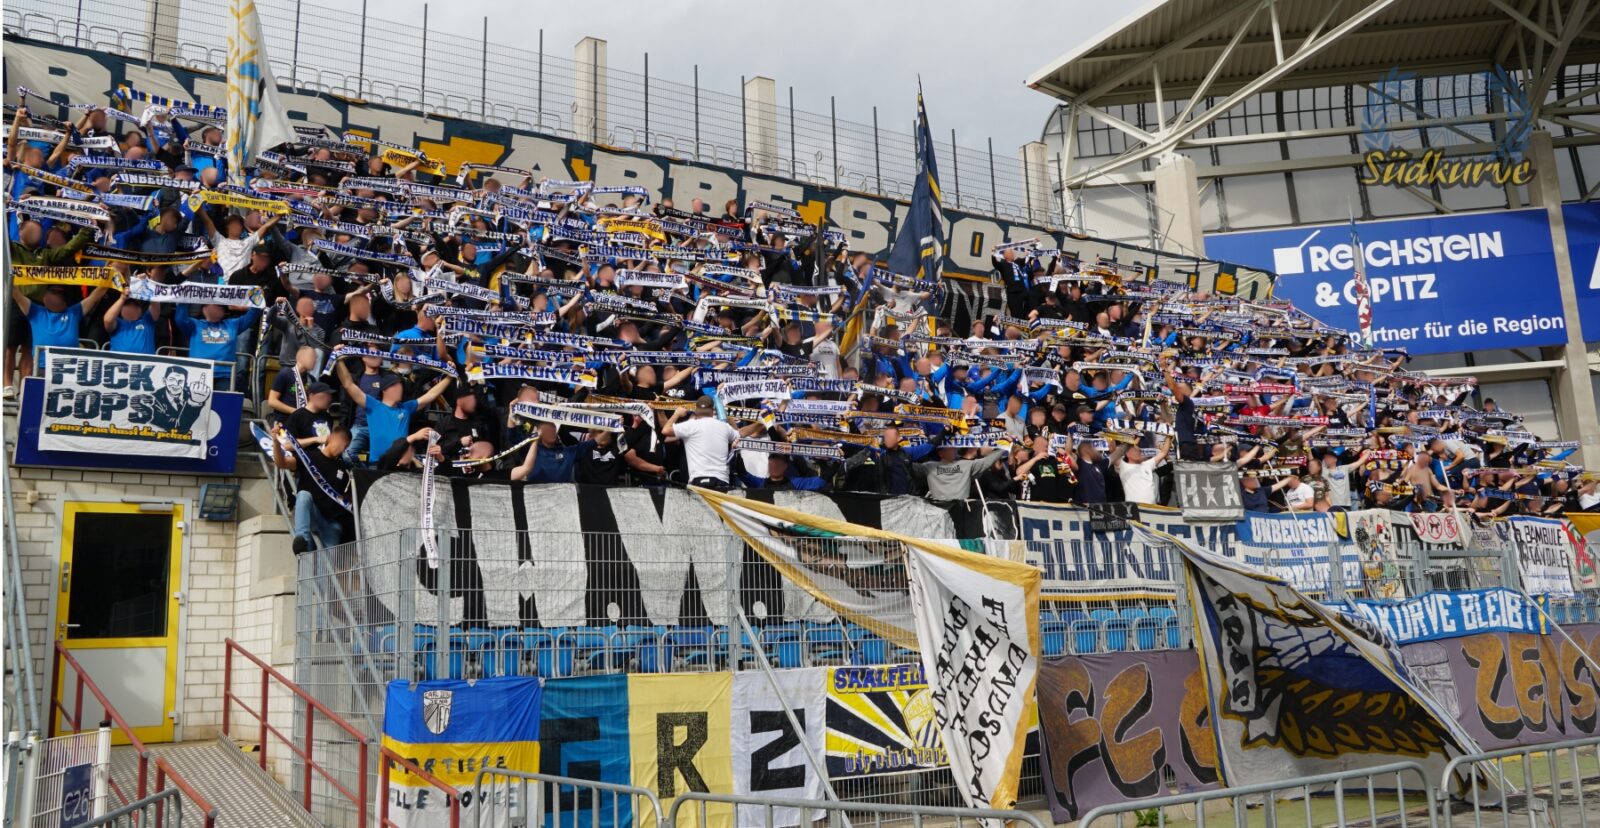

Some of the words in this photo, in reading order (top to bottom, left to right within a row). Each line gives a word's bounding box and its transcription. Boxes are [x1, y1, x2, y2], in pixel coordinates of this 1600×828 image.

[119, 173, 201, 189] UNBEUGSAM
[411, 186, 432, 195] CARL
[432, 188, 456, 198] ZEISS
[337, 221, 369, 236] KURVE
[480, 230, 521, 244] KURVE
[588, 244, 653, 261] SÜDKURVE
[26, 266, 79, 280] KÄMPFERHERZ
[81, 266, 111, 280] SCHLÄGT
[155, 284, 168, 296] DAS
[170, 285, 218, 300] KÄMPFERHERZ
[219, 287, 249, 300] SCHLÄGT
[1315, 282, 1341, 308] &
[1343, 274, 1438, 305] OPITZ
[445, 316, 527, 341] SÜDKURVE
[1424, 320, 1453, 338] für
[1458, 317, 1487, 336] die
[1494, 314, 1564, 337] Region
[484, 344, 574, 363] SÜDKURVE
[51, 358, 156, 392] FUCK
[480, 362, 582, 384] SÜDKURVE
[790, 378, 858, 391] SÜDKURVE
[46, 388, 155, 424] COPS
[628, 402, 650, 417] JENA
[808, 402, 828, 410] ZEISS
[51, 422, 81, 434] ganz
[82, 422, 108, 436] jena
[140, 425, 156, 438] die
[156, 428, 192, 441] polizei
[208, 444, 219, 457] G
[793, 445, 841, 458] NAUMBUR
[1180, 474, 1201, 508] H
[1222, 474, 1242, 507] A
[1250, 517, 1339, 544] UNBEUGSAM
[1524, 525, 1563, 547] BAMBULE
[1458, 589, 1534, 632] BLEIBT
[655, 710, 710, 799] R
[750, 708, 805, 792] Z
[62, 787, 90, 823] C26
